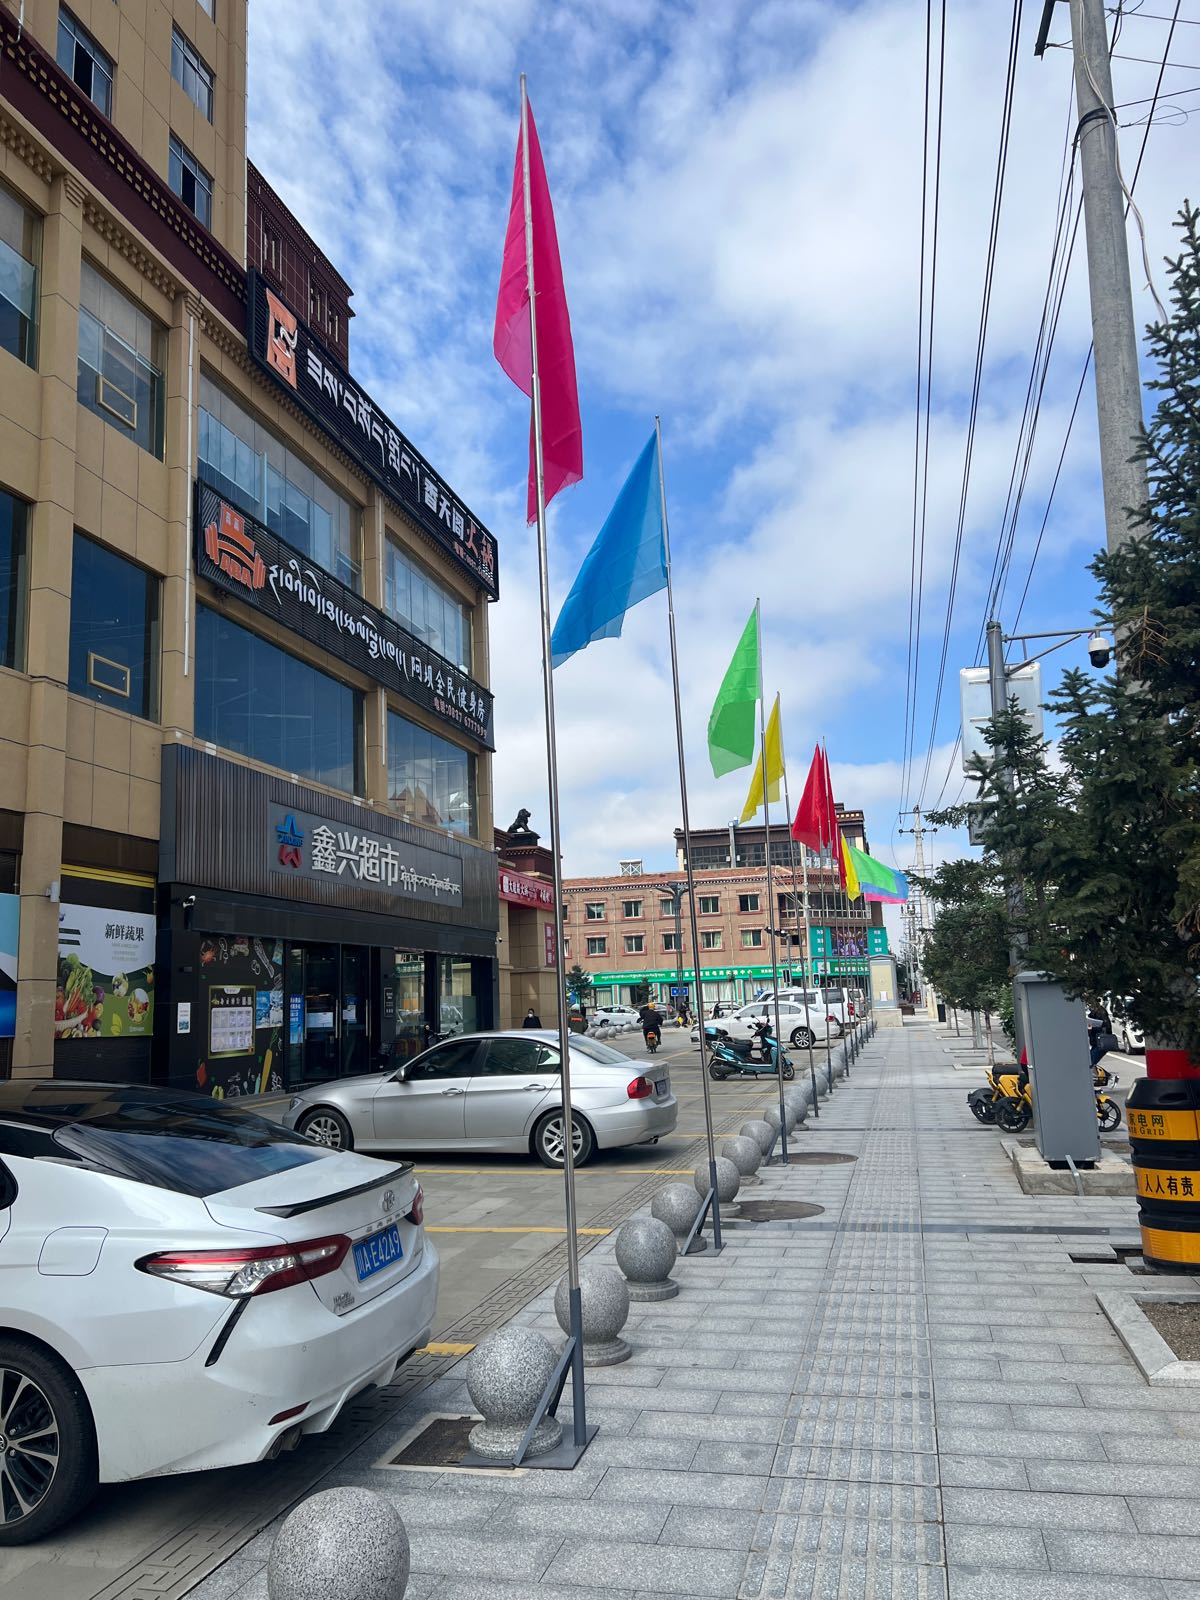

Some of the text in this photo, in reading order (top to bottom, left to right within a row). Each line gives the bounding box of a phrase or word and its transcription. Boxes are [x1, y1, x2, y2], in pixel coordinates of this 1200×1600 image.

[219, 556, 252, 589] ABA
[411, 656, 485, 722] 阿坝全民健身房
[312, 825, 399, 887] 鑫兴超市
[105, 923, 144, 942] 新鲜蔬果
[1145, 1174, 1194, 1197] 人人有责
